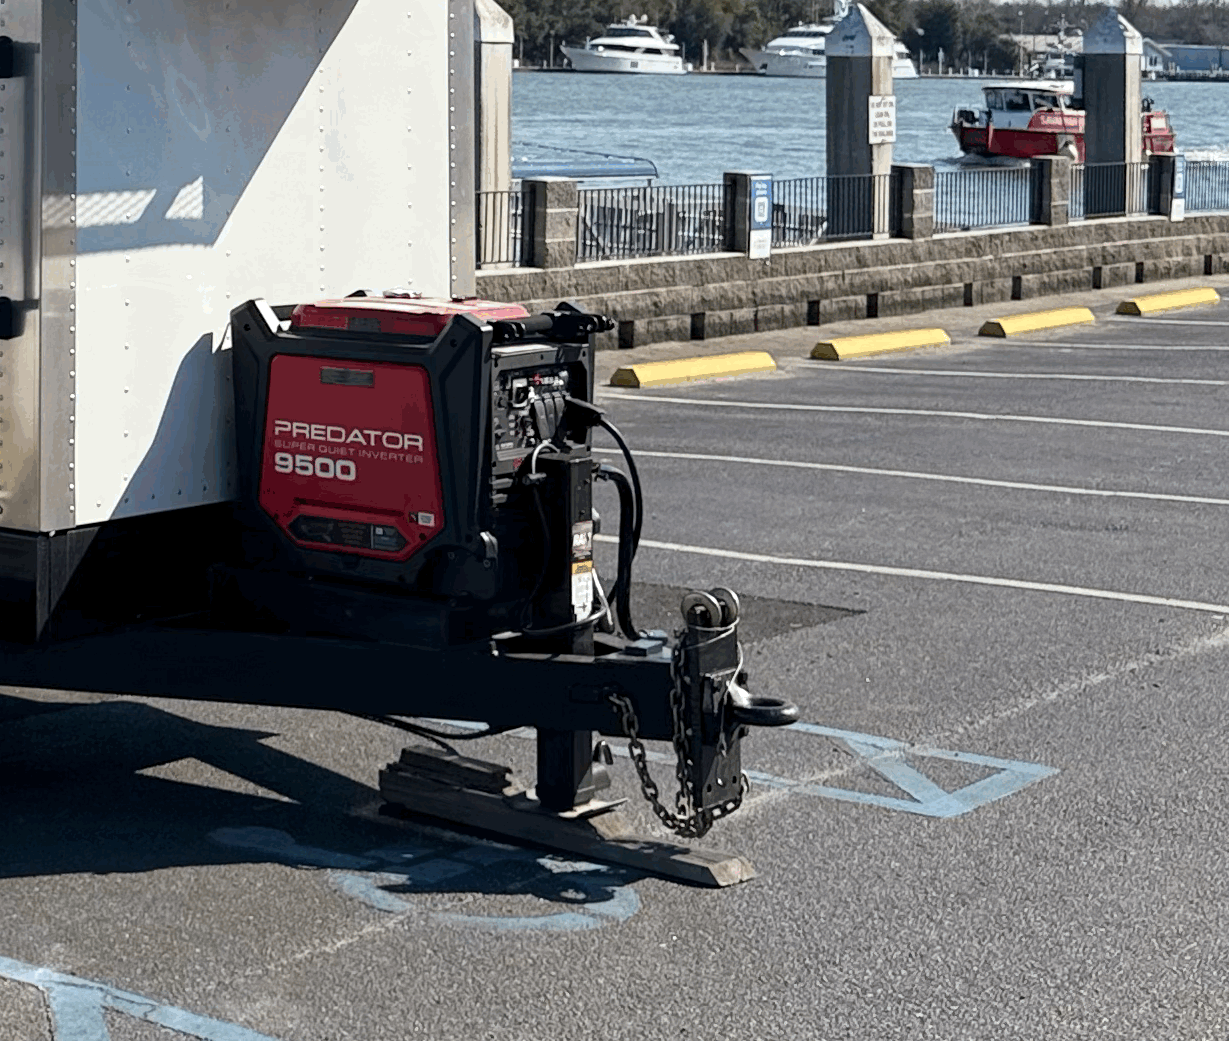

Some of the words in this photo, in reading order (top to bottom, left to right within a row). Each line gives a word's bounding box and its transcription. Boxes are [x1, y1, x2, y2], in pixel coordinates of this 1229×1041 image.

[274, 419, 423, 452] PREDATOR
[274, 439, 316, 452] SUPER
[318, 444, 355, 456] QUIET
[358, 449, 424, 464] INVERTER
[274, 451, 357, 482] 9500
